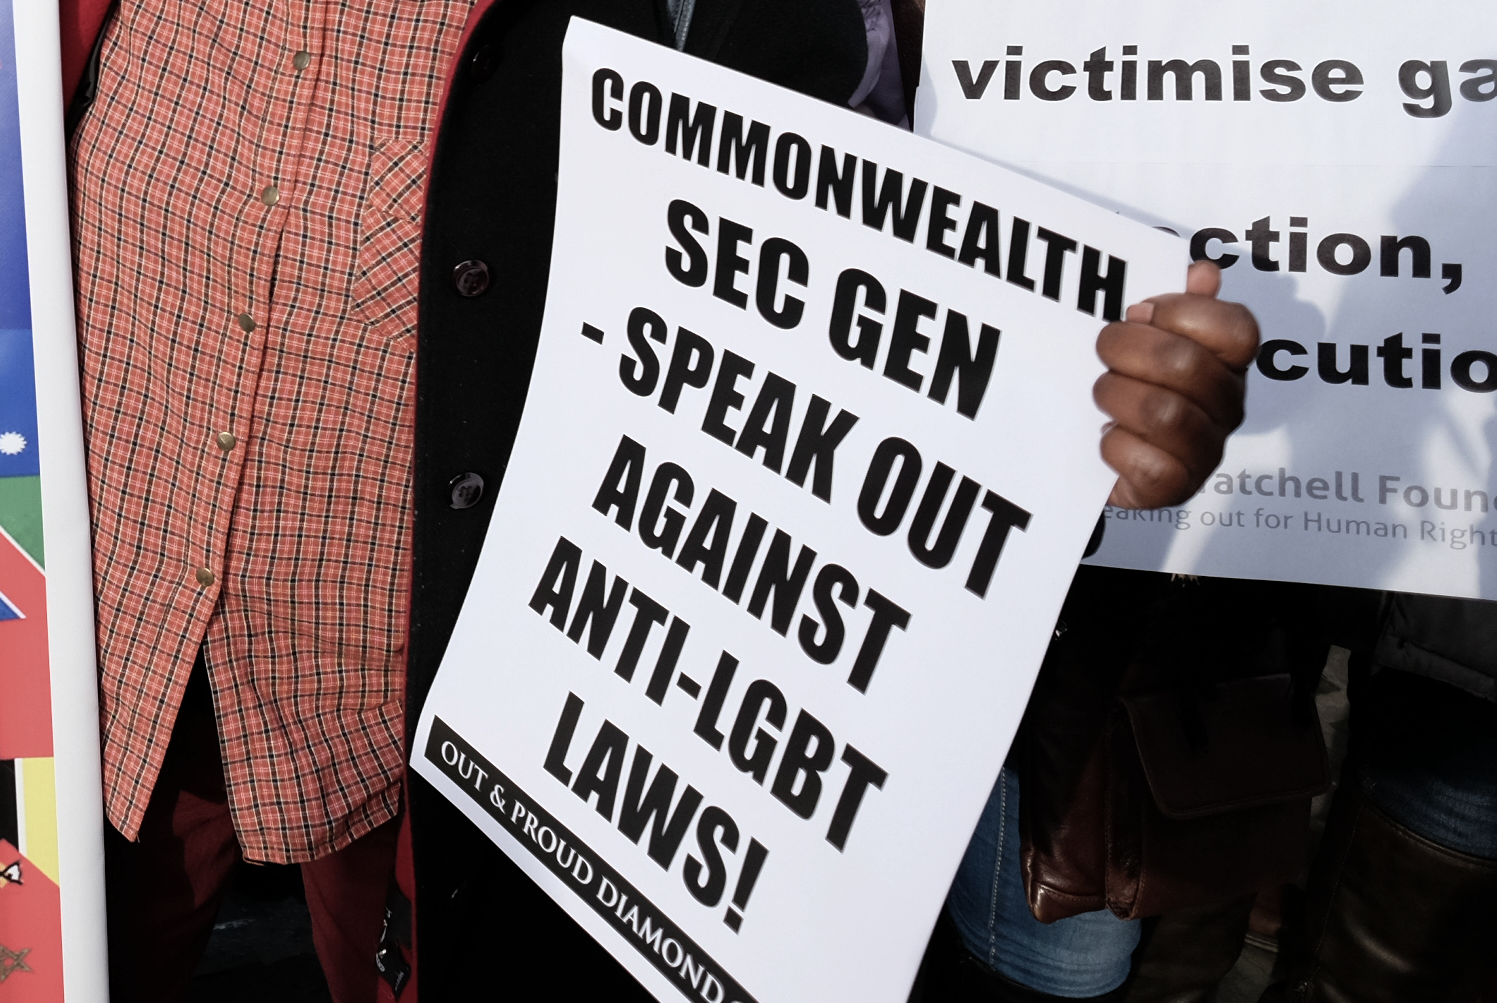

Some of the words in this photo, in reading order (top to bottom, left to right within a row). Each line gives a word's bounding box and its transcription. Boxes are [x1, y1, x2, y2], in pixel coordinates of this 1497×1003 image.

[951, 44, 1365, 103] victimise
[590, 67, 1128, 322] COMMONWEALTH
[665, 198, 809, 330] SEC
[829, 268, 1002, 422] GEN
[1189, 215, 1463, 295] ction,
[619, 306, 861, 505] SPEAK
[856, 436, 1034, 600] OUT
[1256, 332, 1497, 394] cutio
[591, 434, 912, 696] AGAINST
[1200, 508, 1245, 528] out
[1254, 507, 1293, 530] for
[1304, 511, 1407, 539] Human
[1201, 467, 1365, 504] atchell
[1378, 474, 1497, 513] Foun
[528, 535, 889, 854] ANTI-LGBT
[441, 740, 489, 793] OUT
[489, 784, 506, 815] &
[510, 799, 594, 885] PROUD
[596, 875, 725, 1003] DIAMOND
[543, 690, 770, 934] LAWS!
